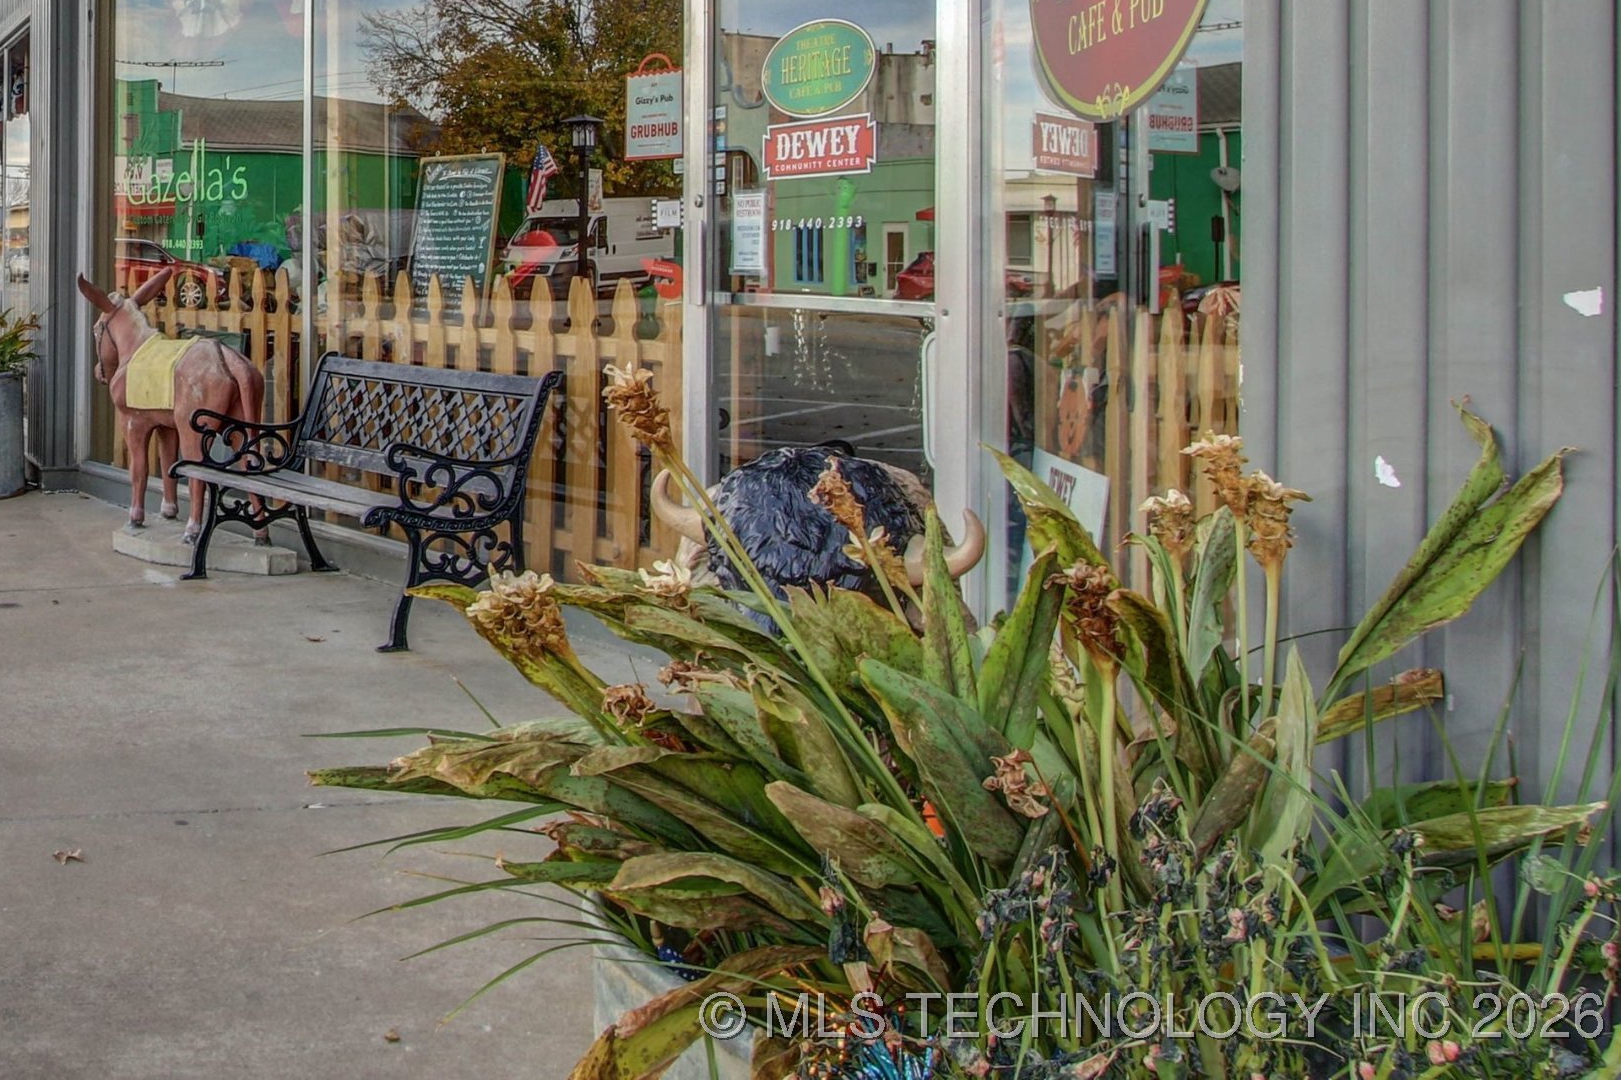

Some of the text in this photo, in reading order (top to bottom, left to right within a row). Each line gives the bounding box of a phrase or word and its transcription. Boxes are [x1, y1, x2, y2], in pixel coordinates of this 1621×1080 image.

[795, 33, 836, 51] THEATRE
[781, 45, 852, 85] HERITAGE
[635, 94, 674, 106] Gizzy's Pub
[630, 122, 678, 139] GRUBHUB
[775, 124, 861, 161] DEWEY
[125, 137, 248, 206] Gazella's
[774, 157, 861, 172] COMMUNITY CENTER
[771, 216, 863, 231] 918.440.2393
[161, 238, 204, 250] 918.4402393
